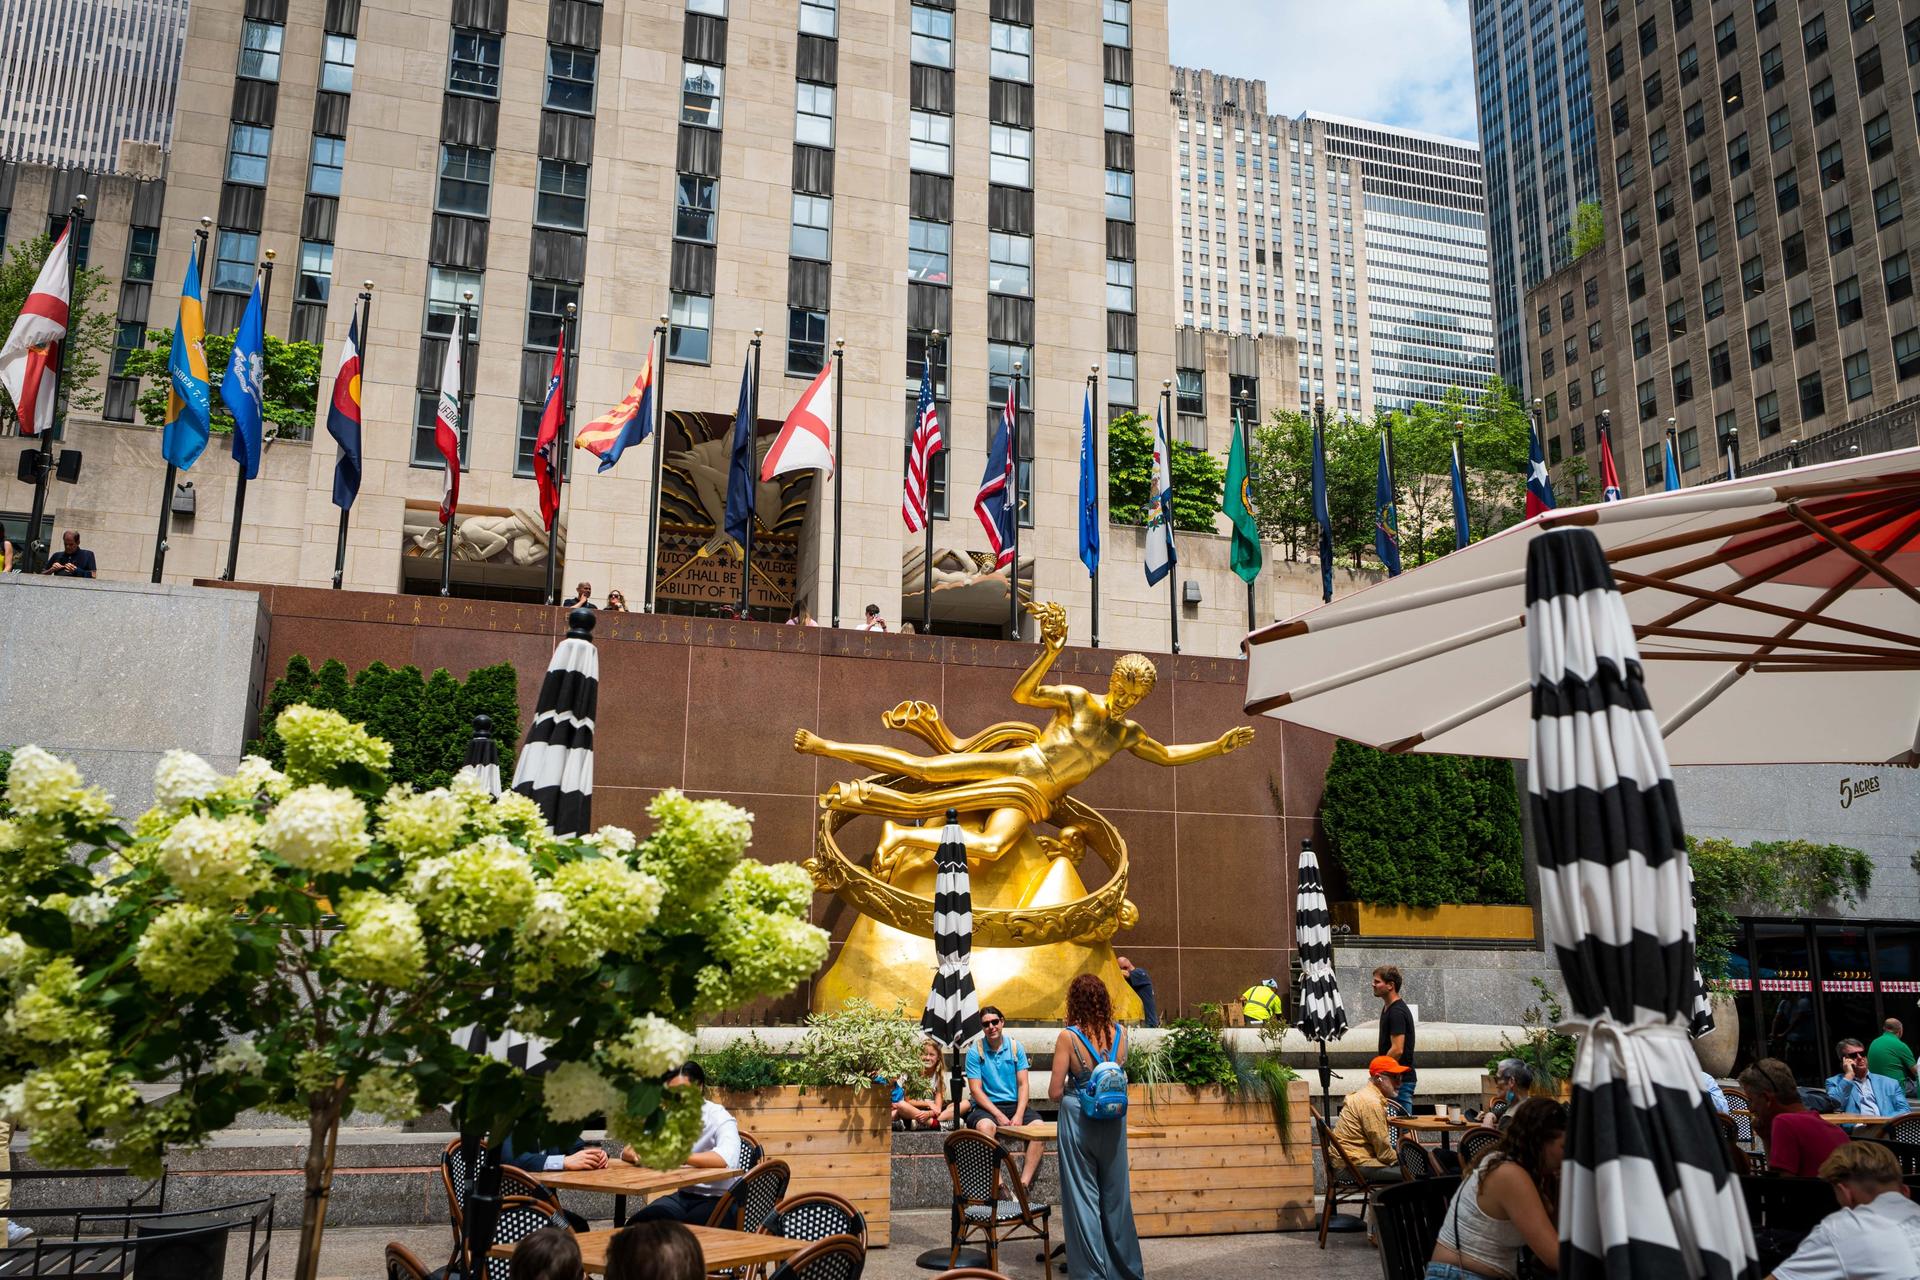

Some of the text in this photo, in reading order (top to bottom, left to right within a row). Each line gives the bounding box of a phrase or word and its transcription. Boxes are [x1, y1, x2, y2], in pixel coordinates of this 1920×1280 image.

[686, 568, 719, 583] SHALL
[723, 571, 737, 584] BE
[707, 585, 726, 598] OF
[1840, 776, 1880, 809] 5 ACRES
